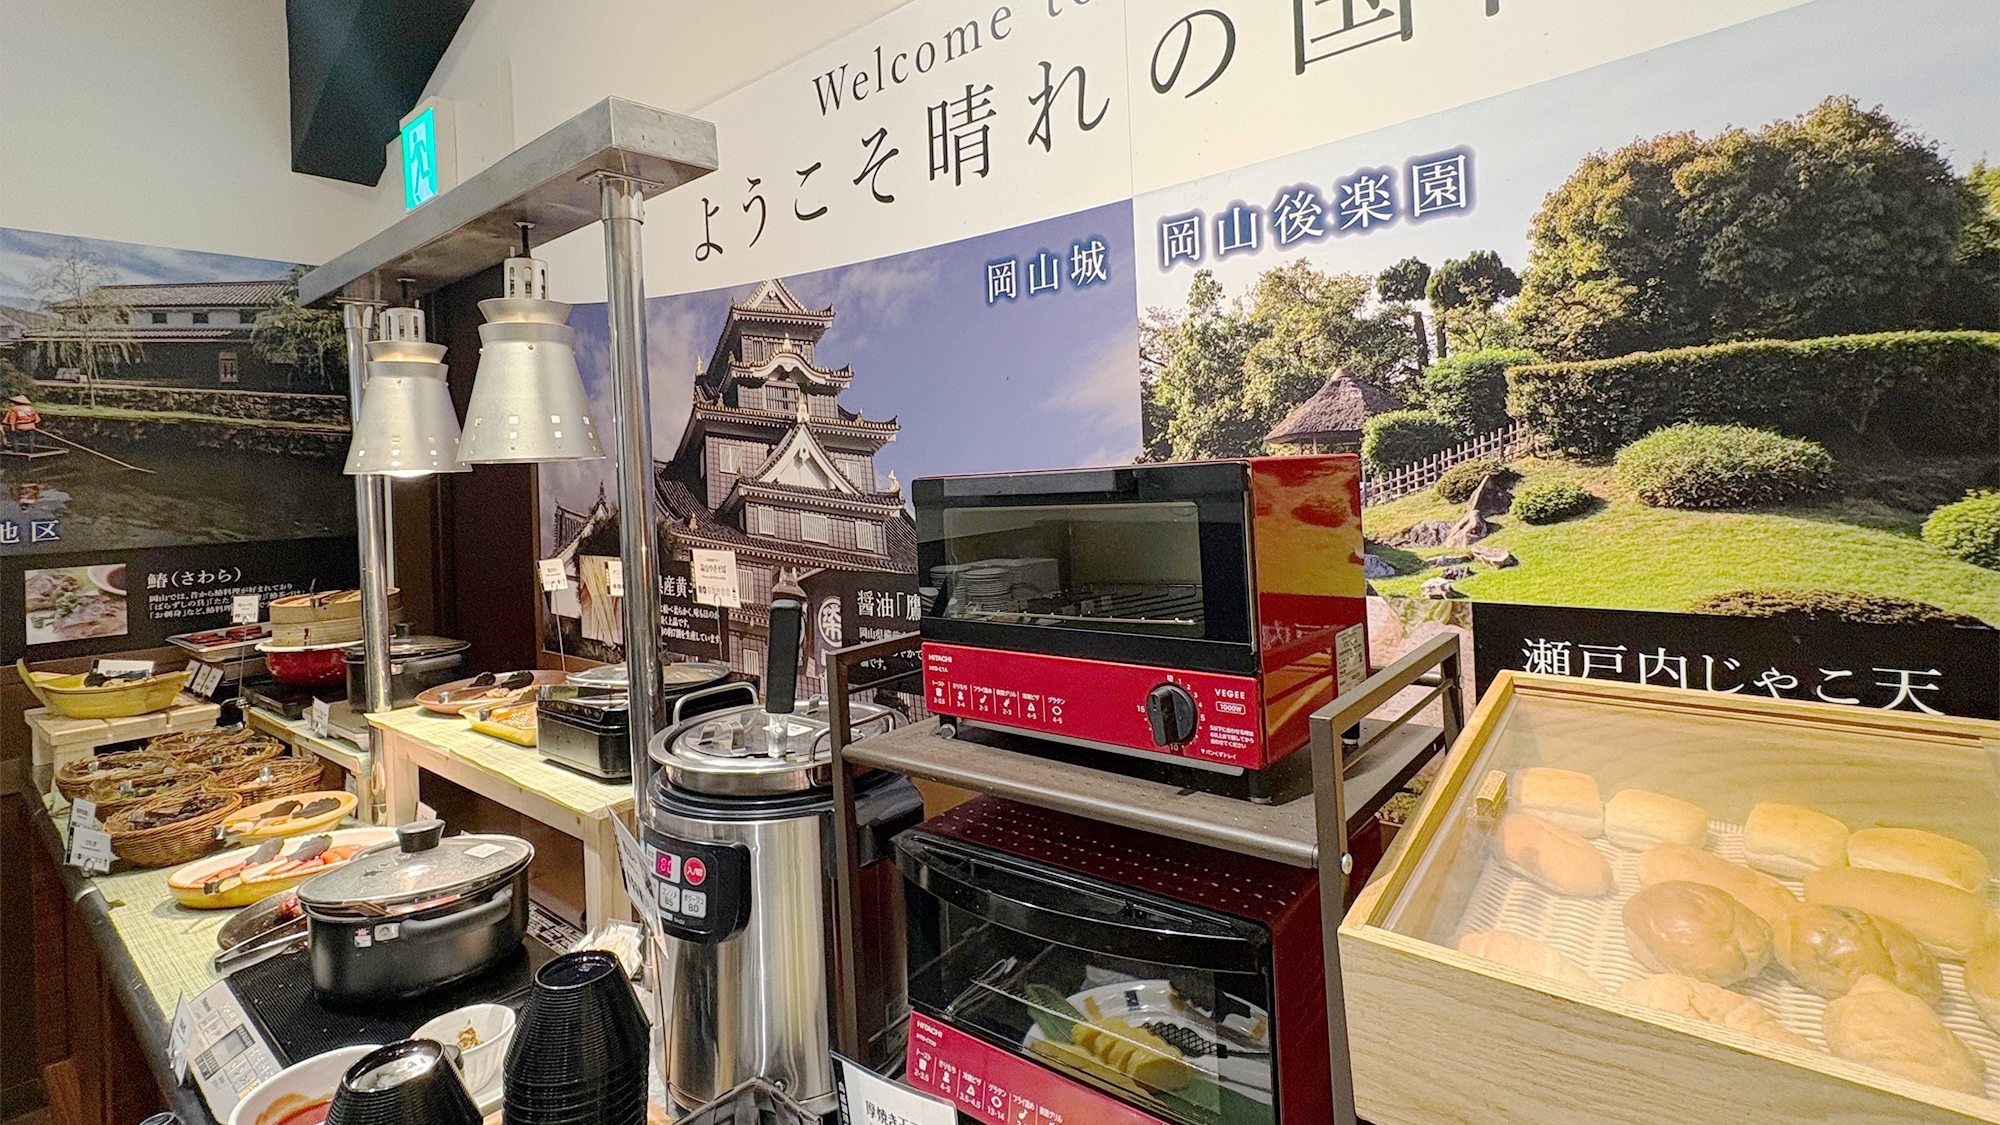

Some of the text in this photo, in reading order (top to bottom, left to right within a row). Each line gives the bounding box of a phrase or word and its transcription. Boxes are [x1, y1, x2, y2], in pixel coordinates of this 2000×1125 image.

[811, 5, 1012, 117] Welcome
[695, 0, 1500, 262] ようこそ晴れの国
[1162, 154, 1467, 267] 岡山後楽園
[986, 240, 1108, 304] 岡山城
[928, 654, 952, 663] HITACHI
[1521, 637, 1946, 717] 瀬戸内じゃこ天
[1214, 688, 1246, 700] VEGEE
[1137, 705, 1146, 713] 15
[1219, 703, 1242, 713] 1000W
[664, 896, 674, 907] 85
[687, 903, 700, 913] 80
[916, 1020, 943, 1039] HITACHI
[915, 1048, 932, 1061] トースト
[988, 1083, 1007, 1098] グラタン
[959, 1093, 982, 1110] 3.5-4.5
[987, 1105, 1006, 1121] 13-14
